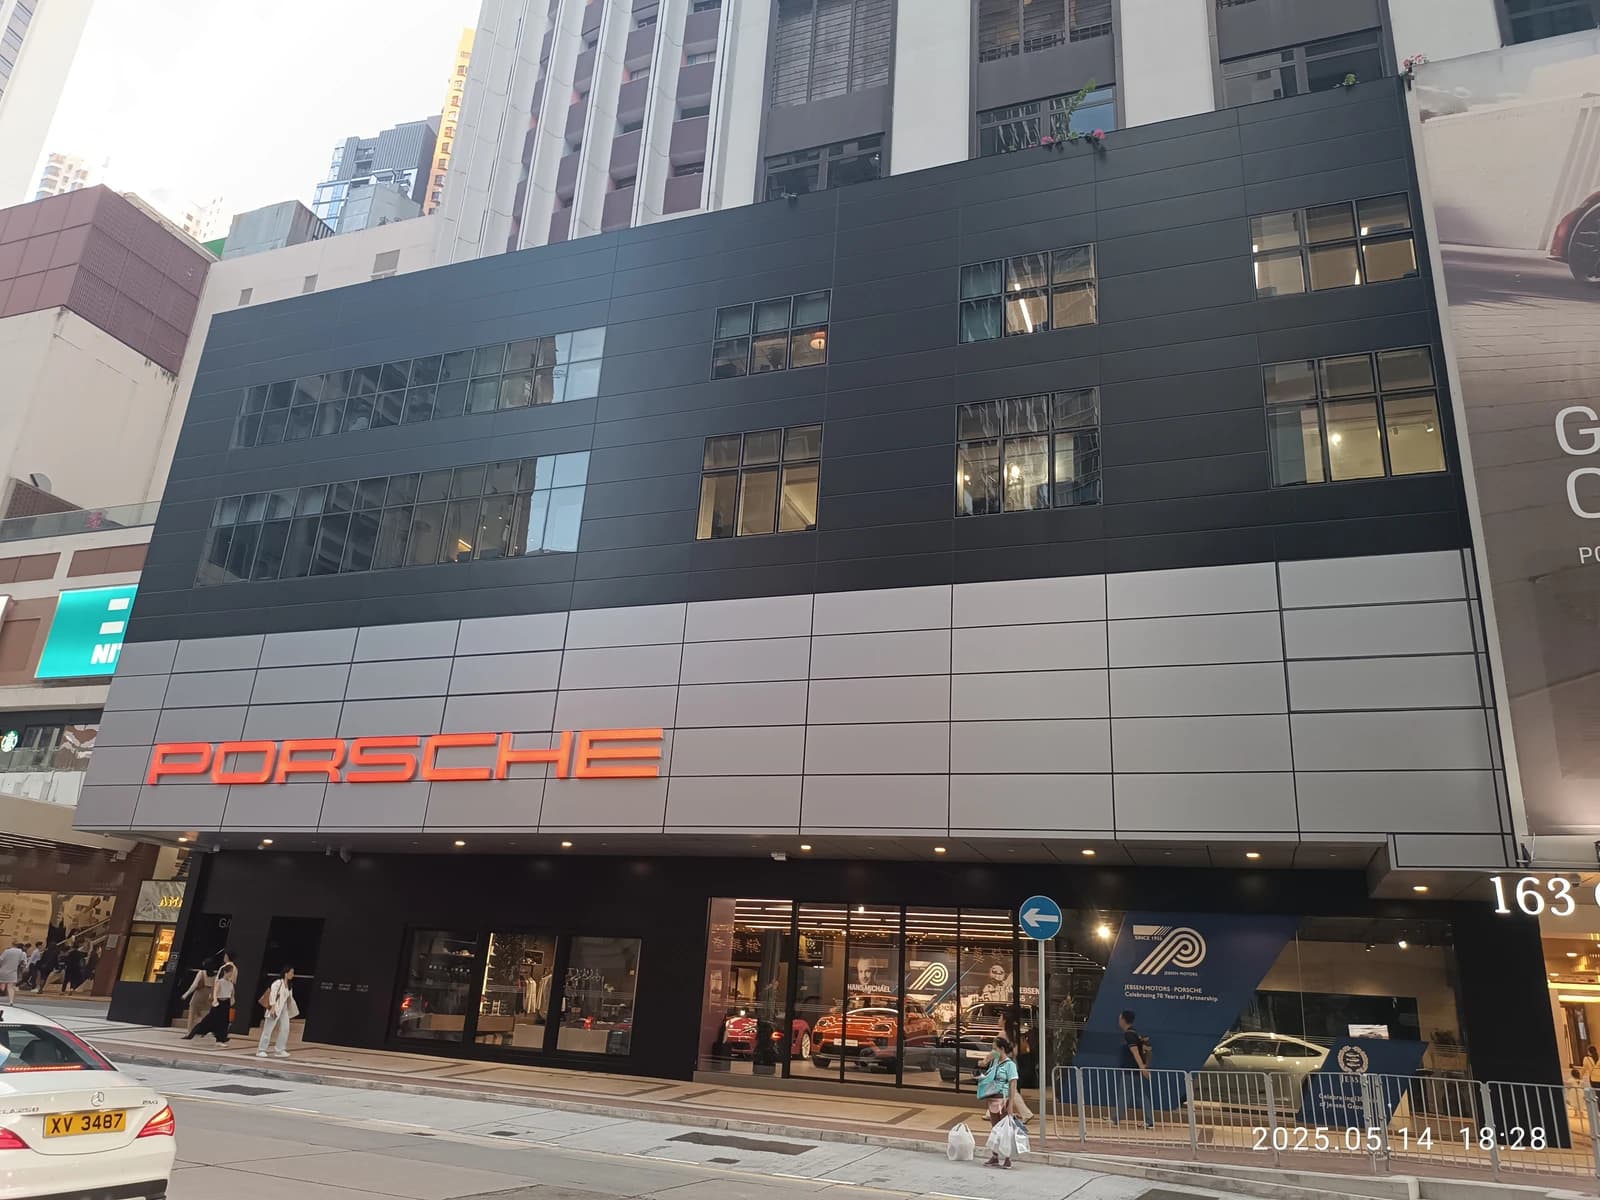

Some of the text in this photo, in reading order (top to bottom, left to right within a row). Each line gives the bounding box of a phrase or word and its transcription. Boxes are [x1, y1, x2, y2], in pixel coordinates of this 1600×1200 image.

[147, 728, 664, 786] PORSCHE
[1489, 876, 1575, 917] 163
[1174, 986, 1202, 994] PORSCHE
[51, 1113, 123, 1134] XV 3487
